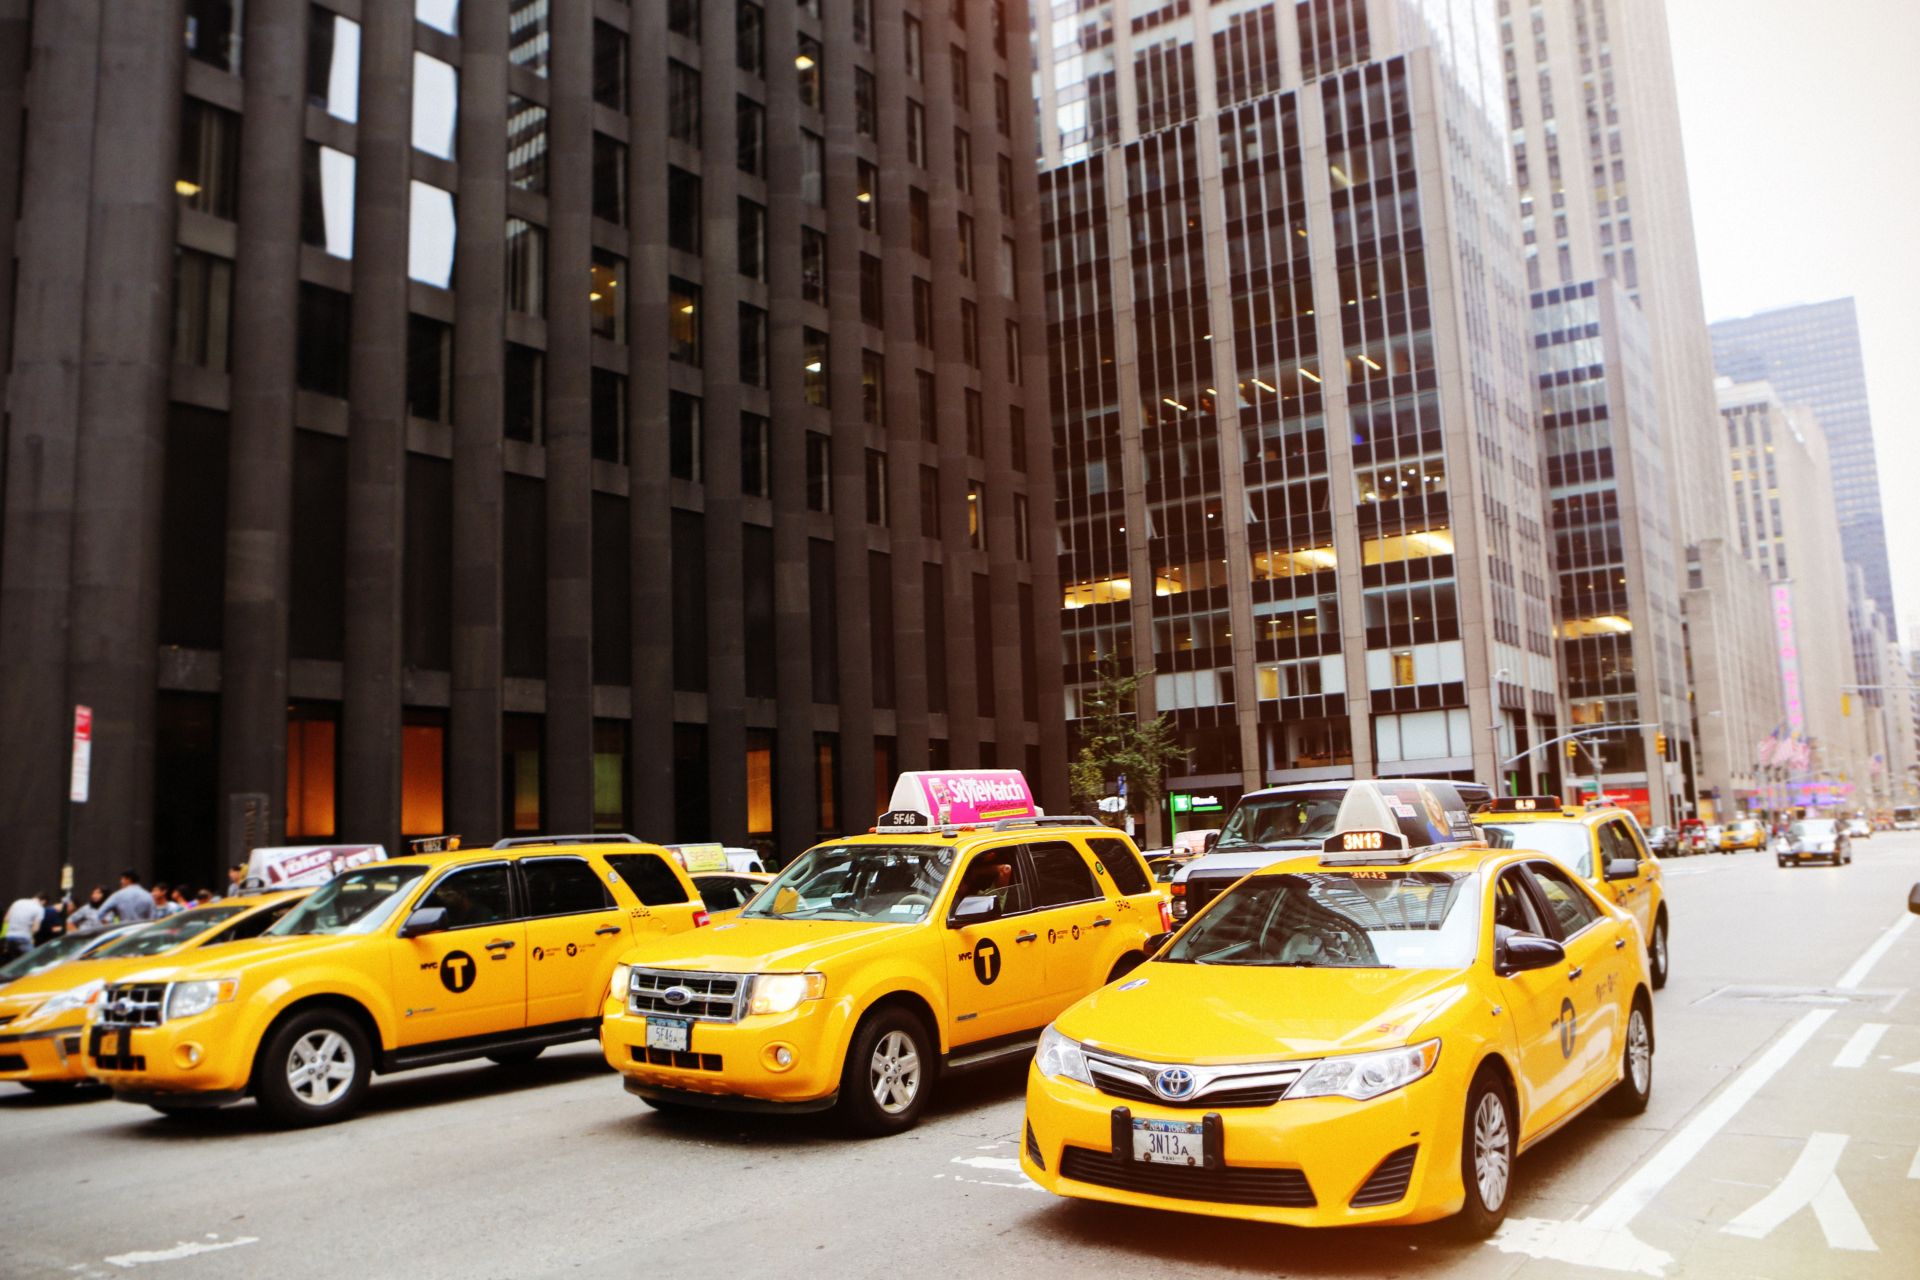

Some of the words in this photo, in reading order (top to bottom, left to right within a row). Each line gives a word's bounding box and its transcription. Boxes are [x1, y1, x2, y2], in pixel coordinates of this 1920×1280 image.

[947, 777, 1026, 809] StyleWatch
[893, 813, 916, 825] 5F46
[1343, 833, 1382, 850] 3N13
[446, 957, 469, 989] T
[957, 951, 973, 962] NYC
[978, 946, 995, 980] T
